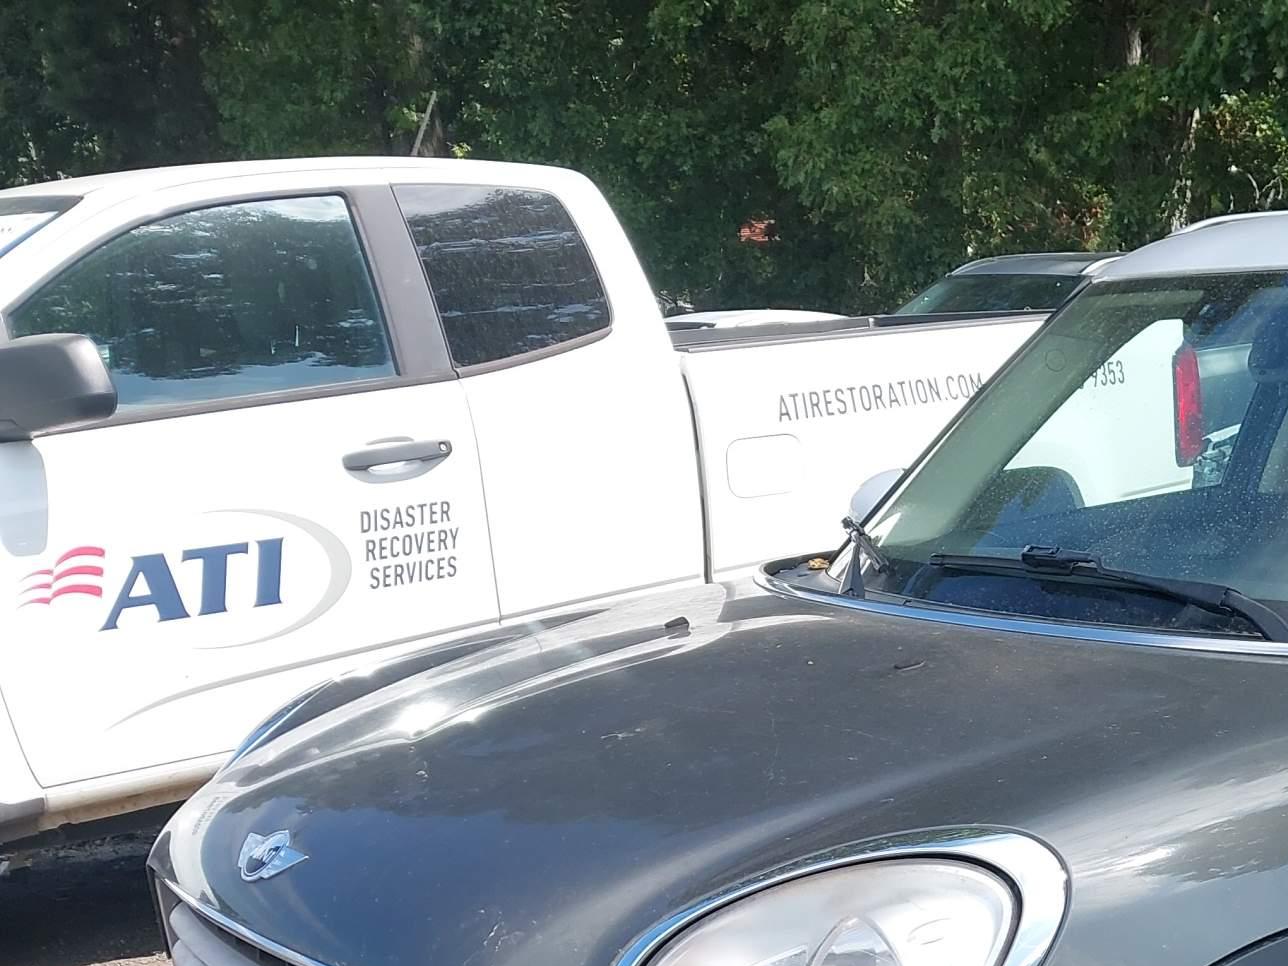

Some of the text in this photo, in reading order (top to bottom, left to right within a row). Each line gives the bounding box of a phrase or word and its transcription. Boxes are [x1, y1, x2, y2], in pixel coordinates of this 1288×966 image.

[778, 372, 985, 422] ATIRESTORATION.COM
[360, 501, 452, 533] DISASTER
[365, 527, 459, 562] RECOVERY
[98, 537, 284, 632] ATI
[369, 556, 458, 590] SERVICES
